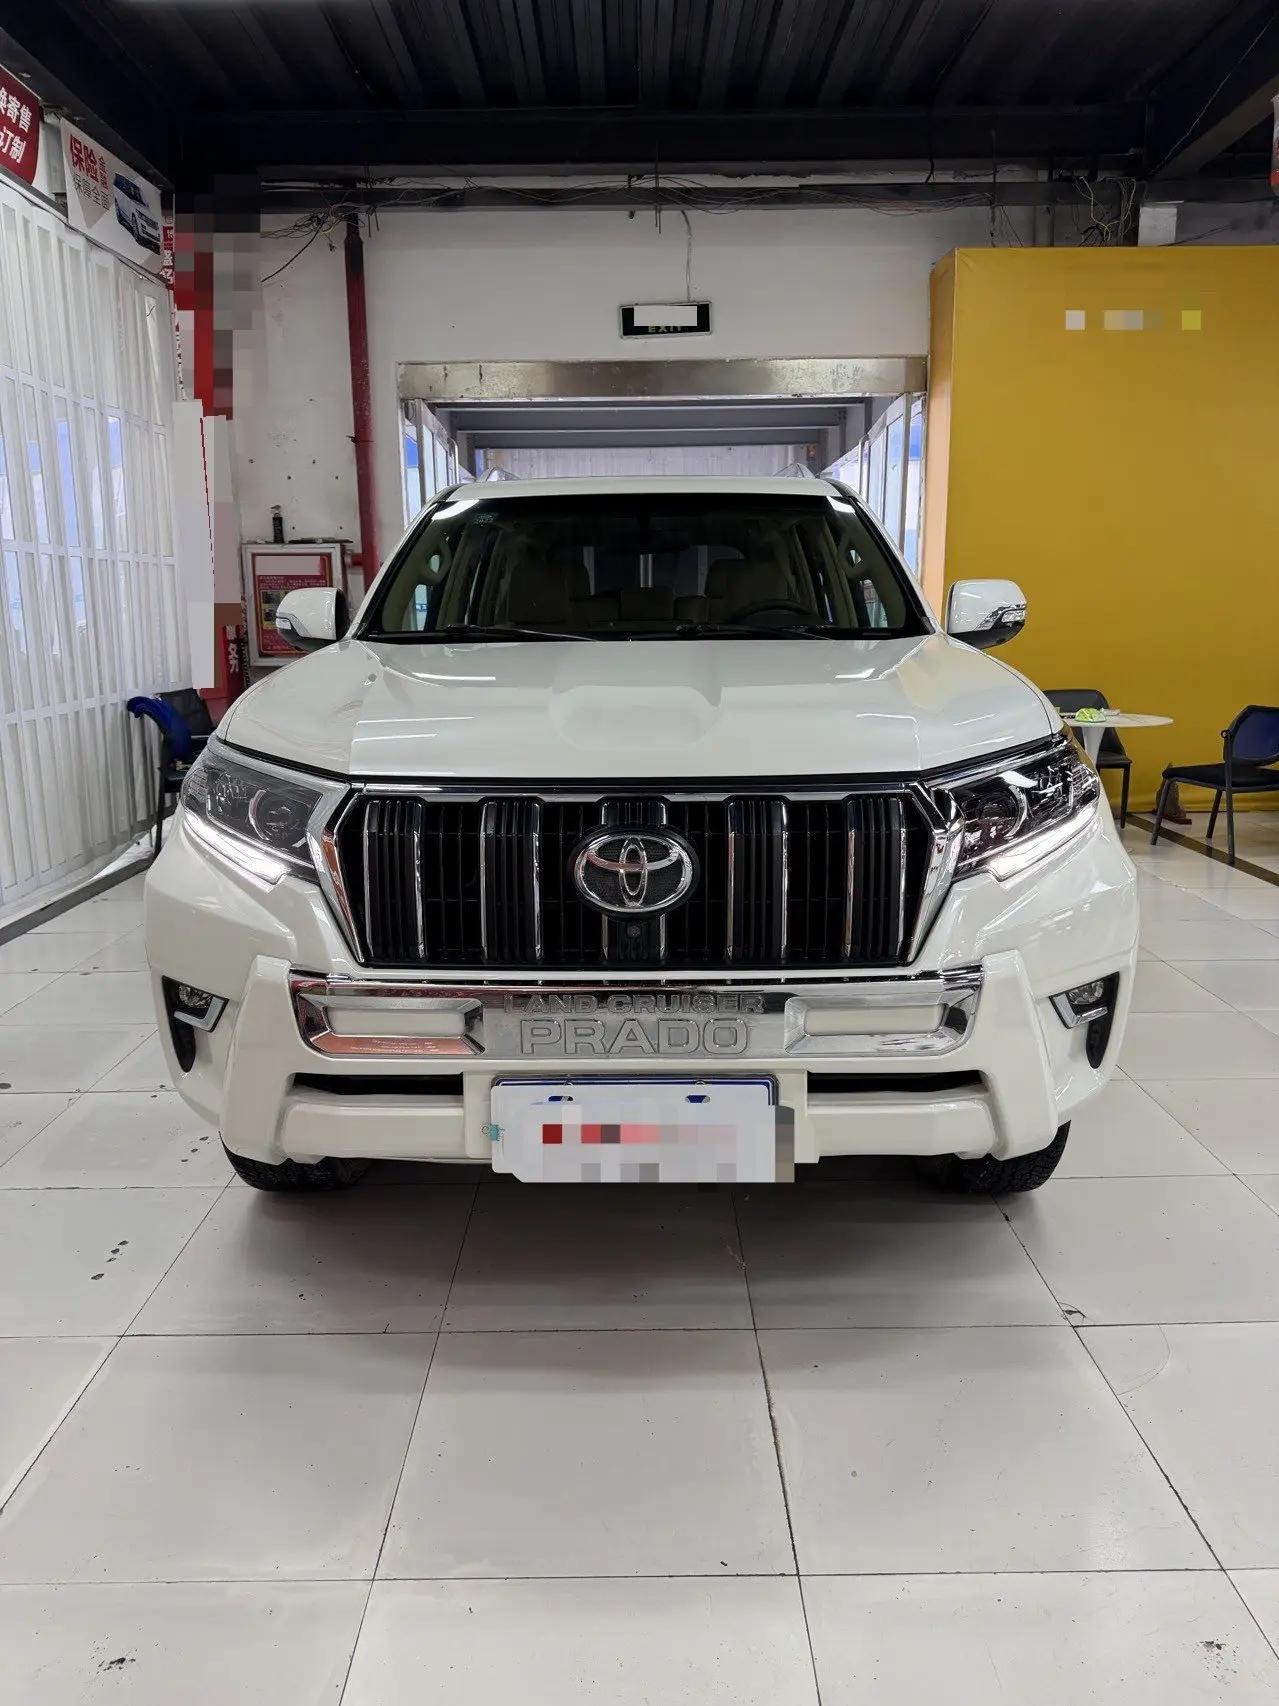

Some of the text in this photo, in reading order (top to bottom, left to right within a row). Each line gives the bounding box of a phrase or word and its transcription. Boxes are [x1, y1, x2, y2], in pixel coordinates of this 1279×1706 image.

[70, 134, 99, 183] 保险
[504, 994, 766, 1014] LAND CRUISER
[520, 1017, 749, 1054] PRADO
